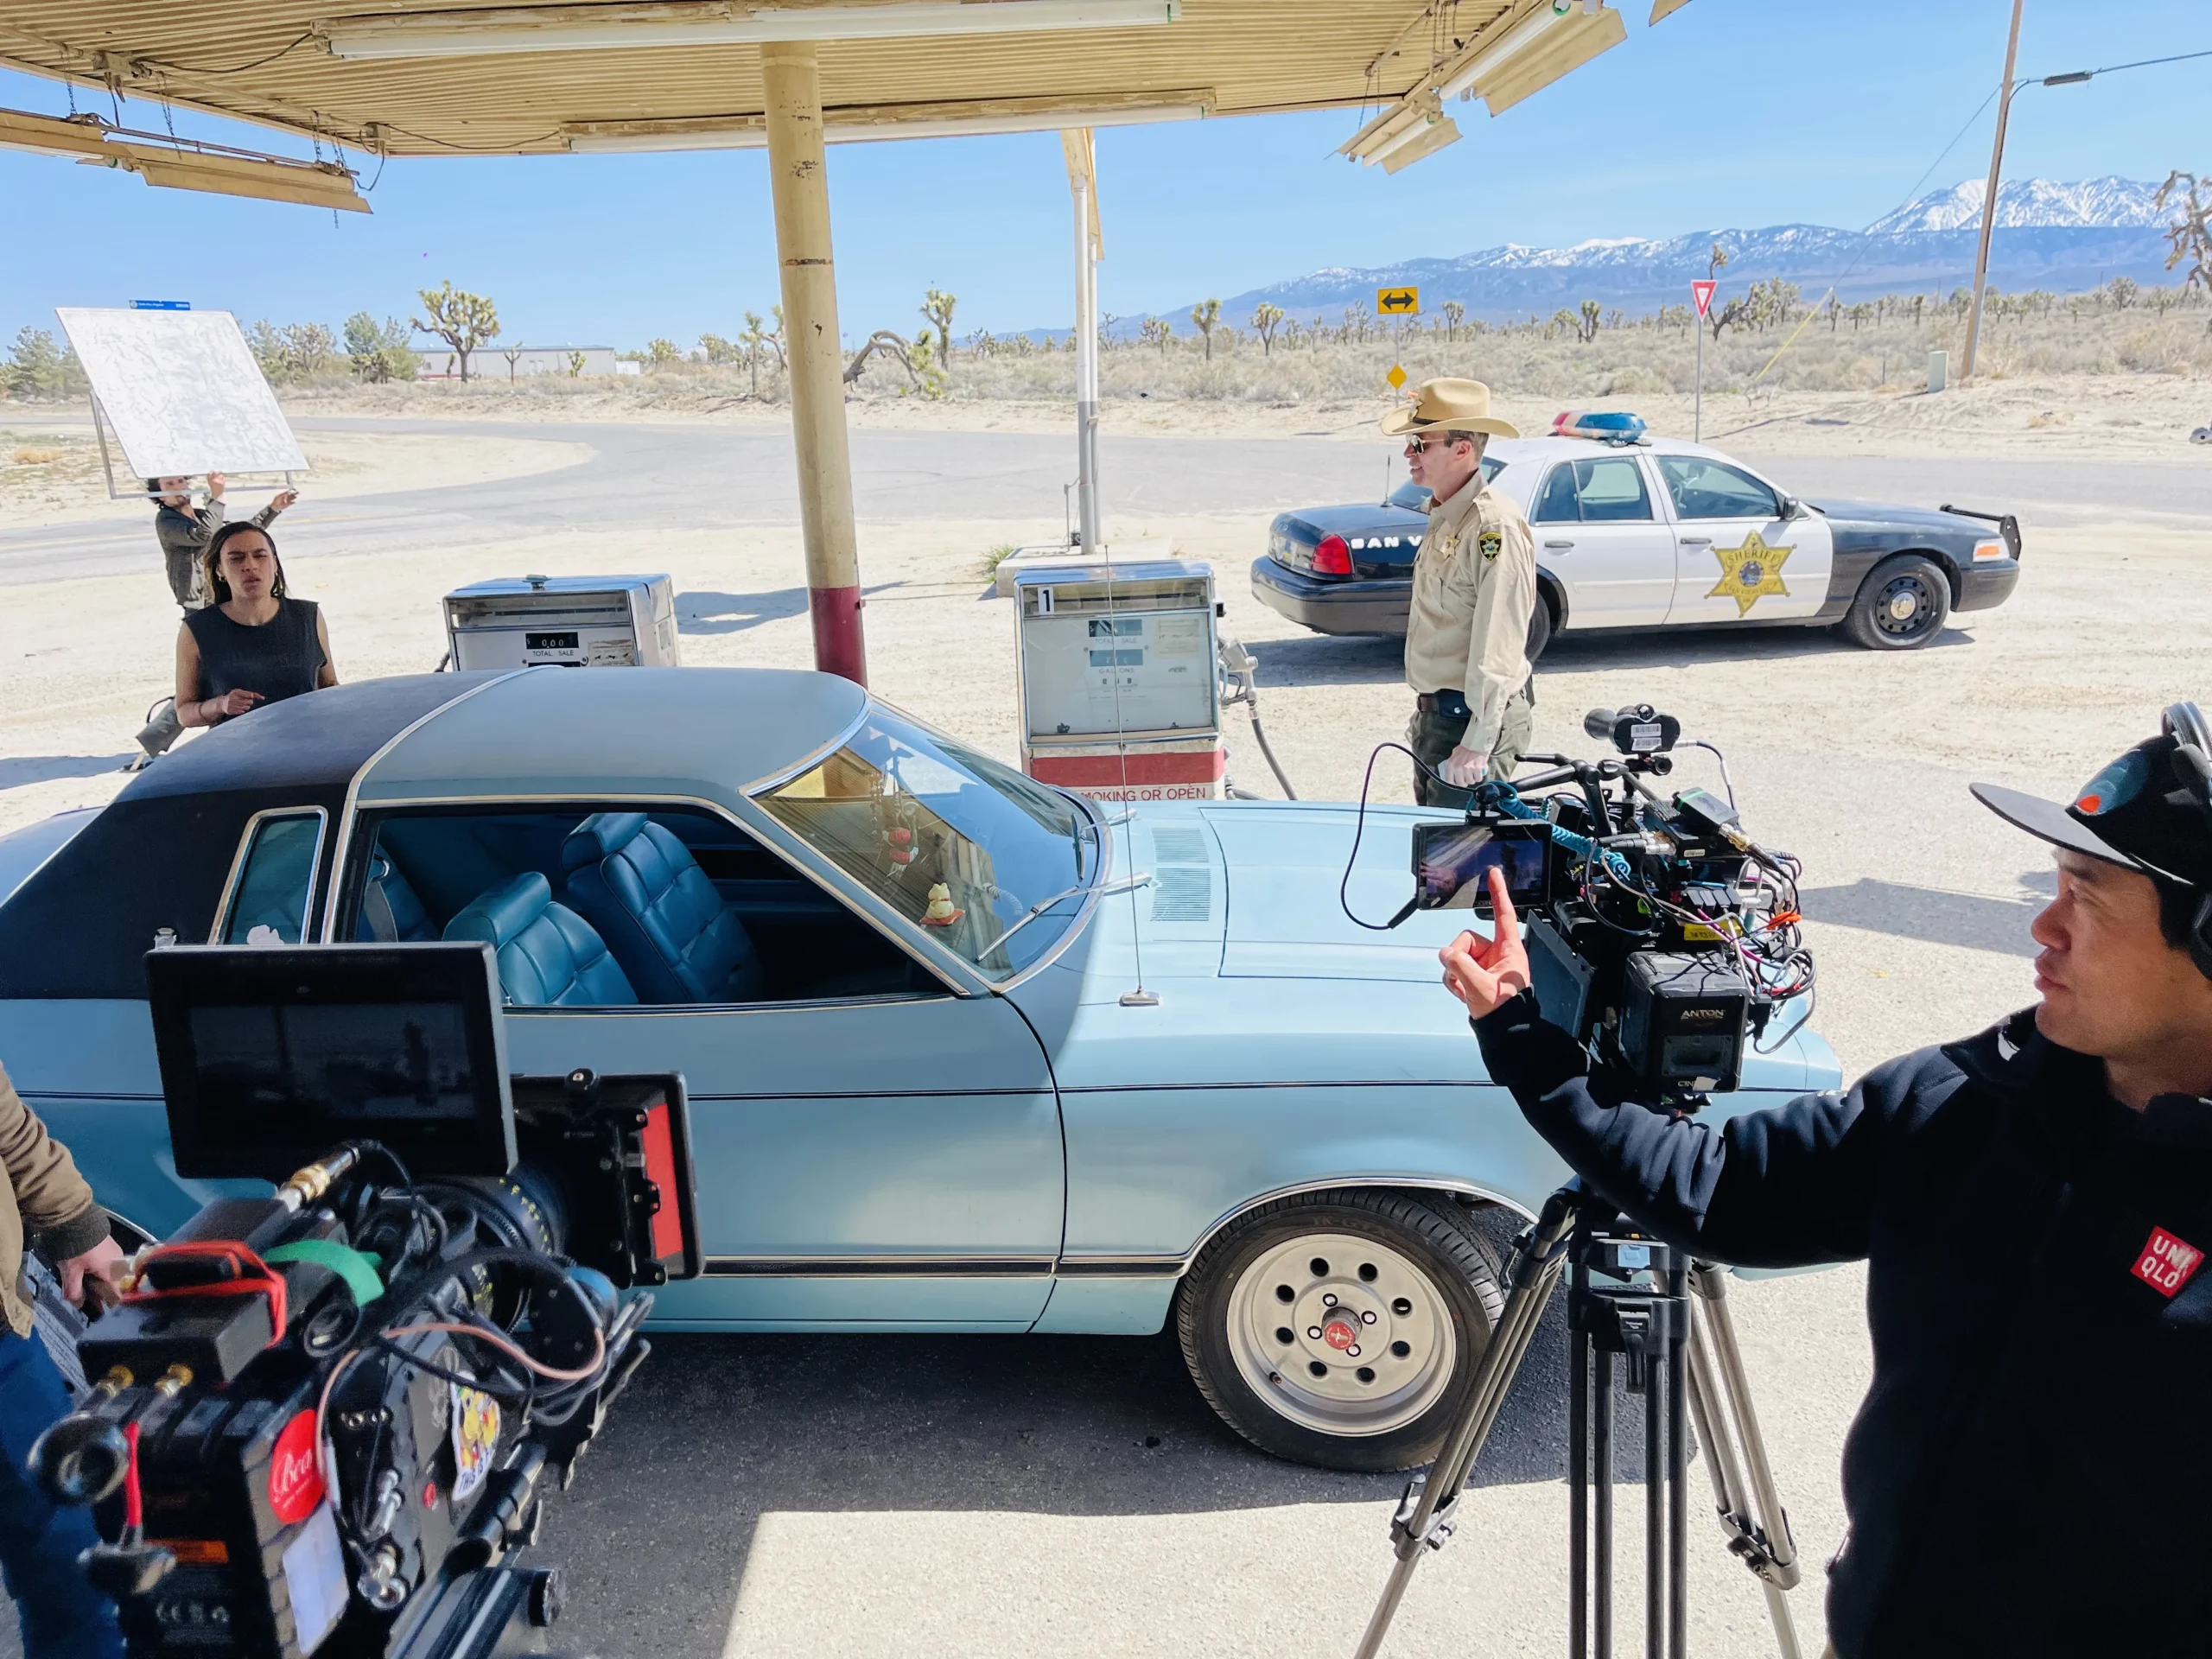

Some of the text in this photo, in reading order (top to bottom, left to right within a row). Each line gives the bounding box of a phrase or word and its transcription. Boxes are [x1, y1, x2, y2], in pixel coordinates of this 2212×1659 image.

[1351, 537, 1399, 550] SAN
[1728, 549, 1777, 563] SHERIFF
[1042, 589, 1051, 612] 1
[1141, 789, 1161, 800] OR
[1166, 787, 1206, 800] OPEN
[1681, 1009, 1725, 1020] ANTON
[2141, 1255, 2179, 1288] QLO
[458, 1471, 476, 1493] THIS
